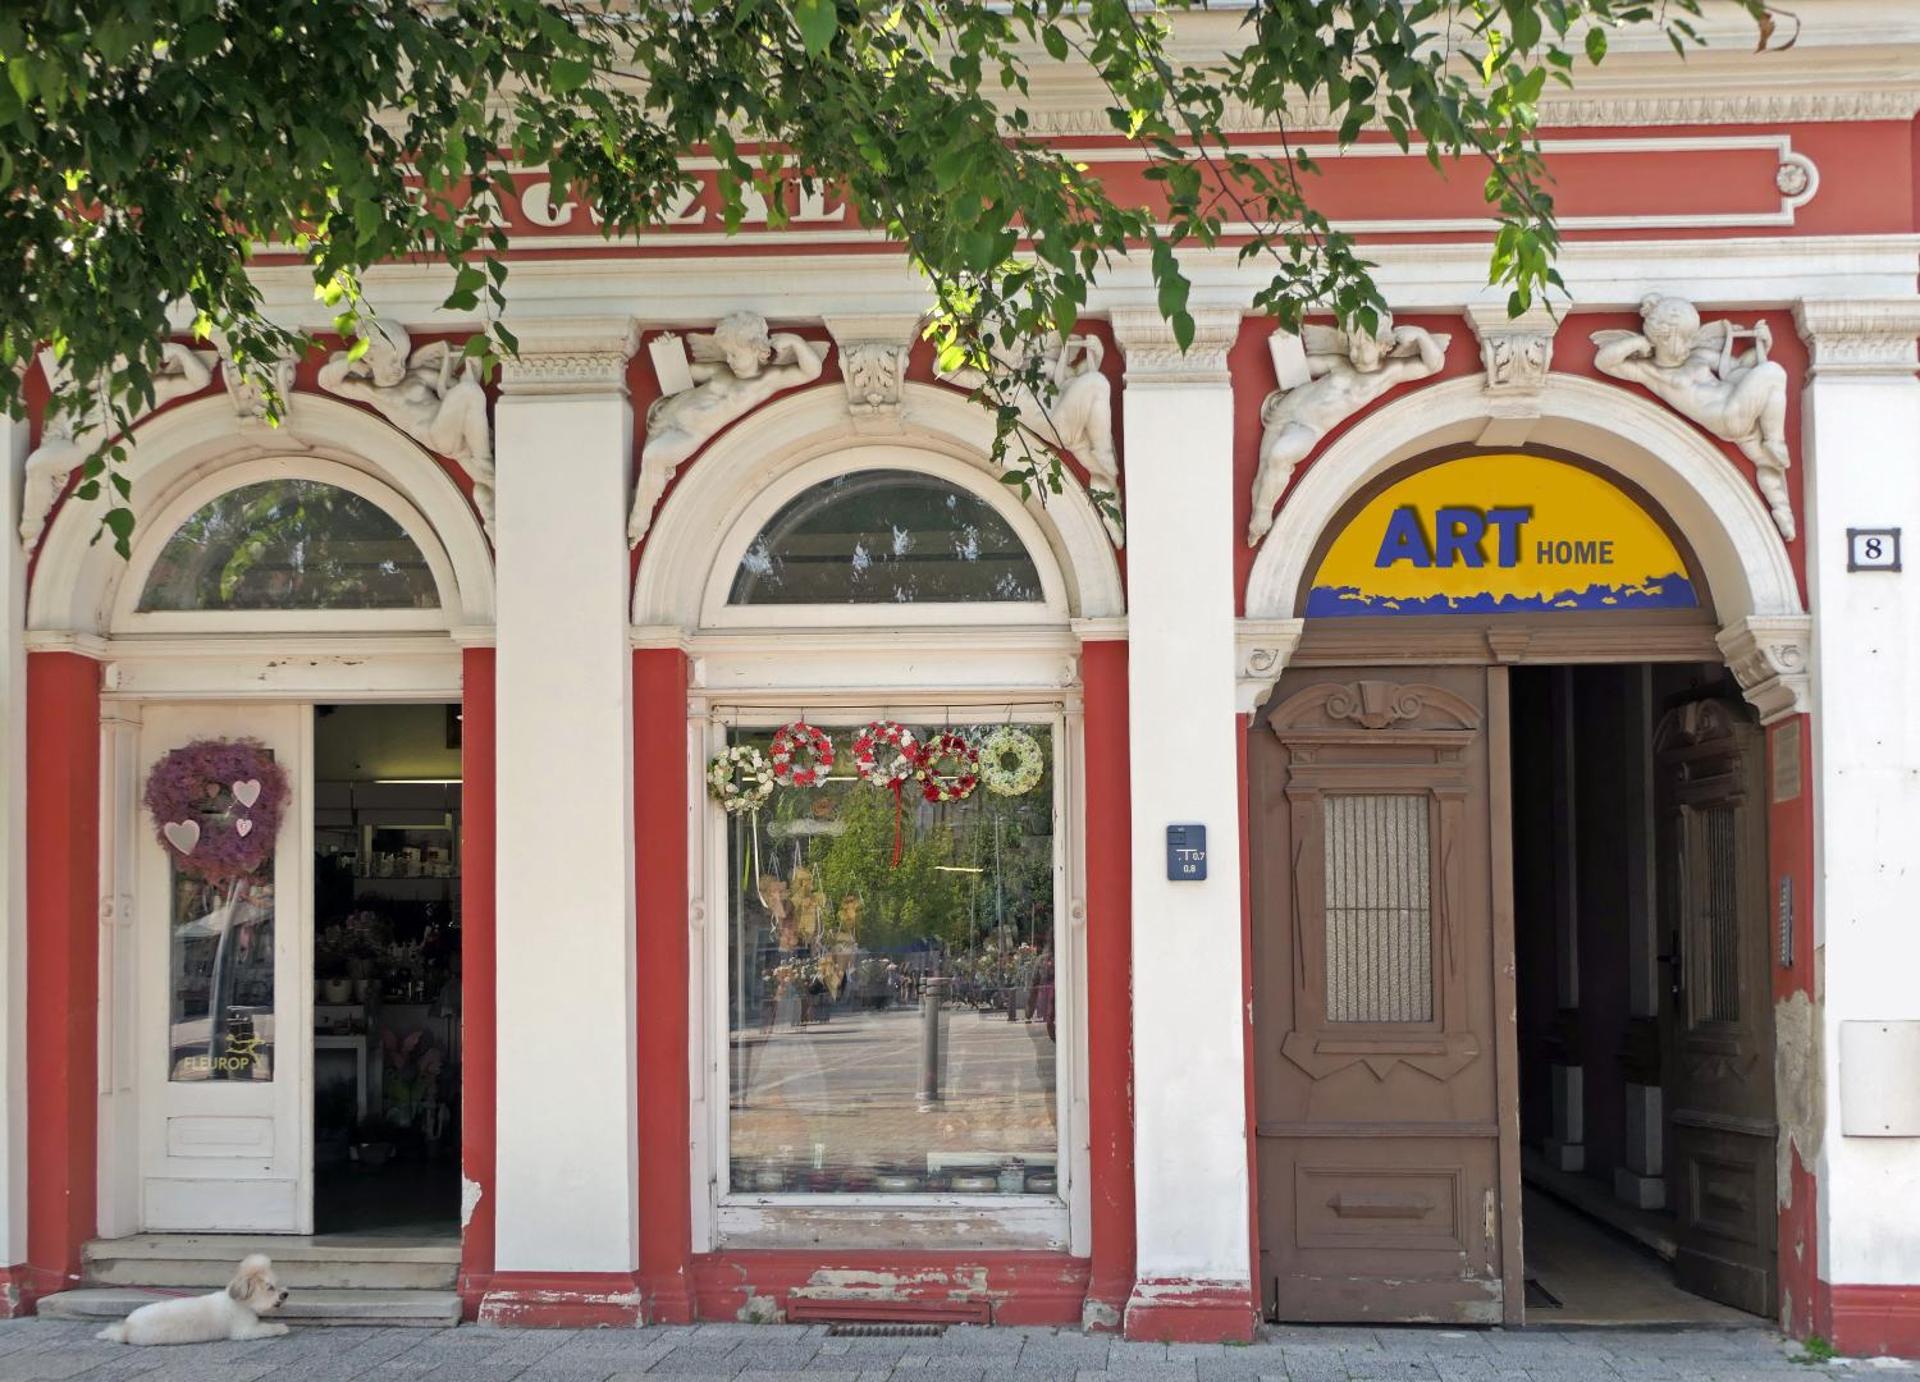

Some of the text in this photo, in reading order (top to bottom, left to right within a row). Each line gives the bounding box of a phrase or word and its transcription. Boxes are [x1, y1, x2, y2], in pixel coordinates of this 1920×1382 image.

[1375, 506, 1613, 568] ART HOME
[1866, 538, 1882, 559] 8
[184, 1057, 249, 1070] FLEUROP
